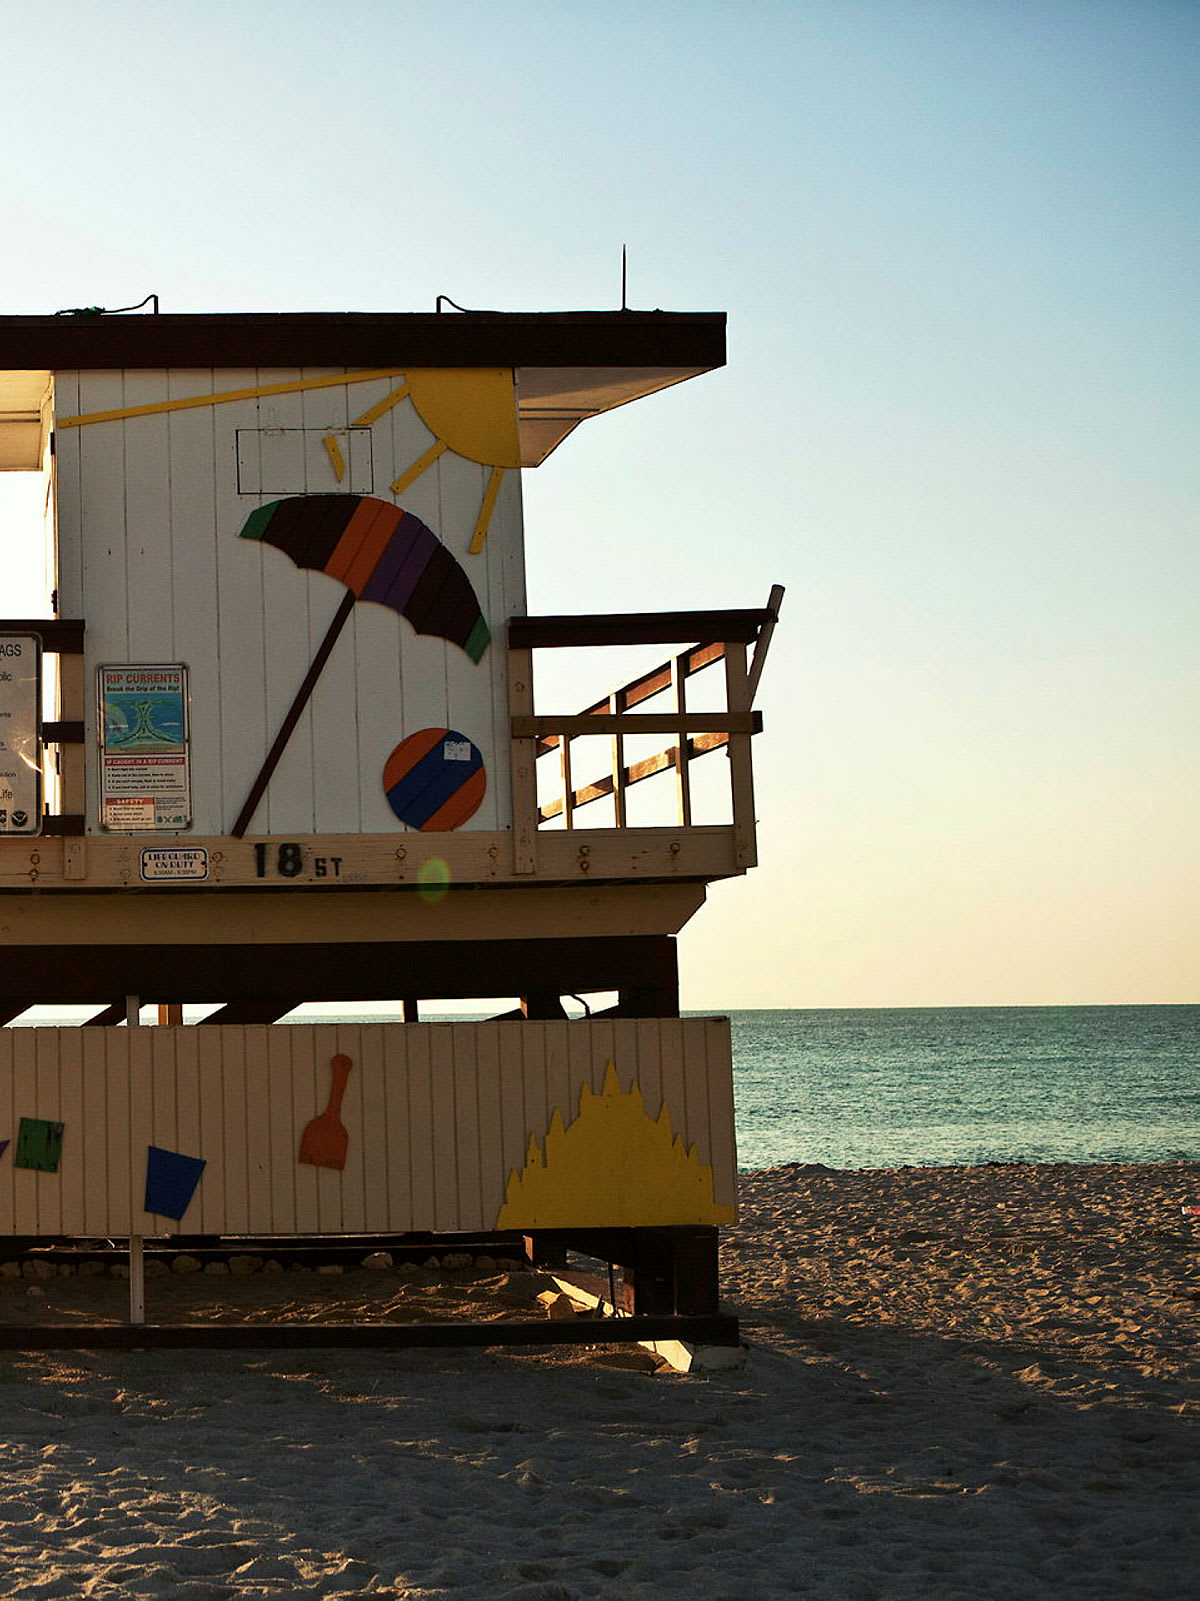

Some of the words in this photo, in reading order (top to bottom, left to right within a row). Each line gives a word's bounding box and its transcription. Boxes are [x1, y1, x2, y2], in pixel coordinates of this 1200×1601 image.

[106, 674, 123, 684] RIP
[125, 673, 180, 684] CURRENTS
[254, 842, 304, 878] 18
[314, 857, 342, 877] ST
